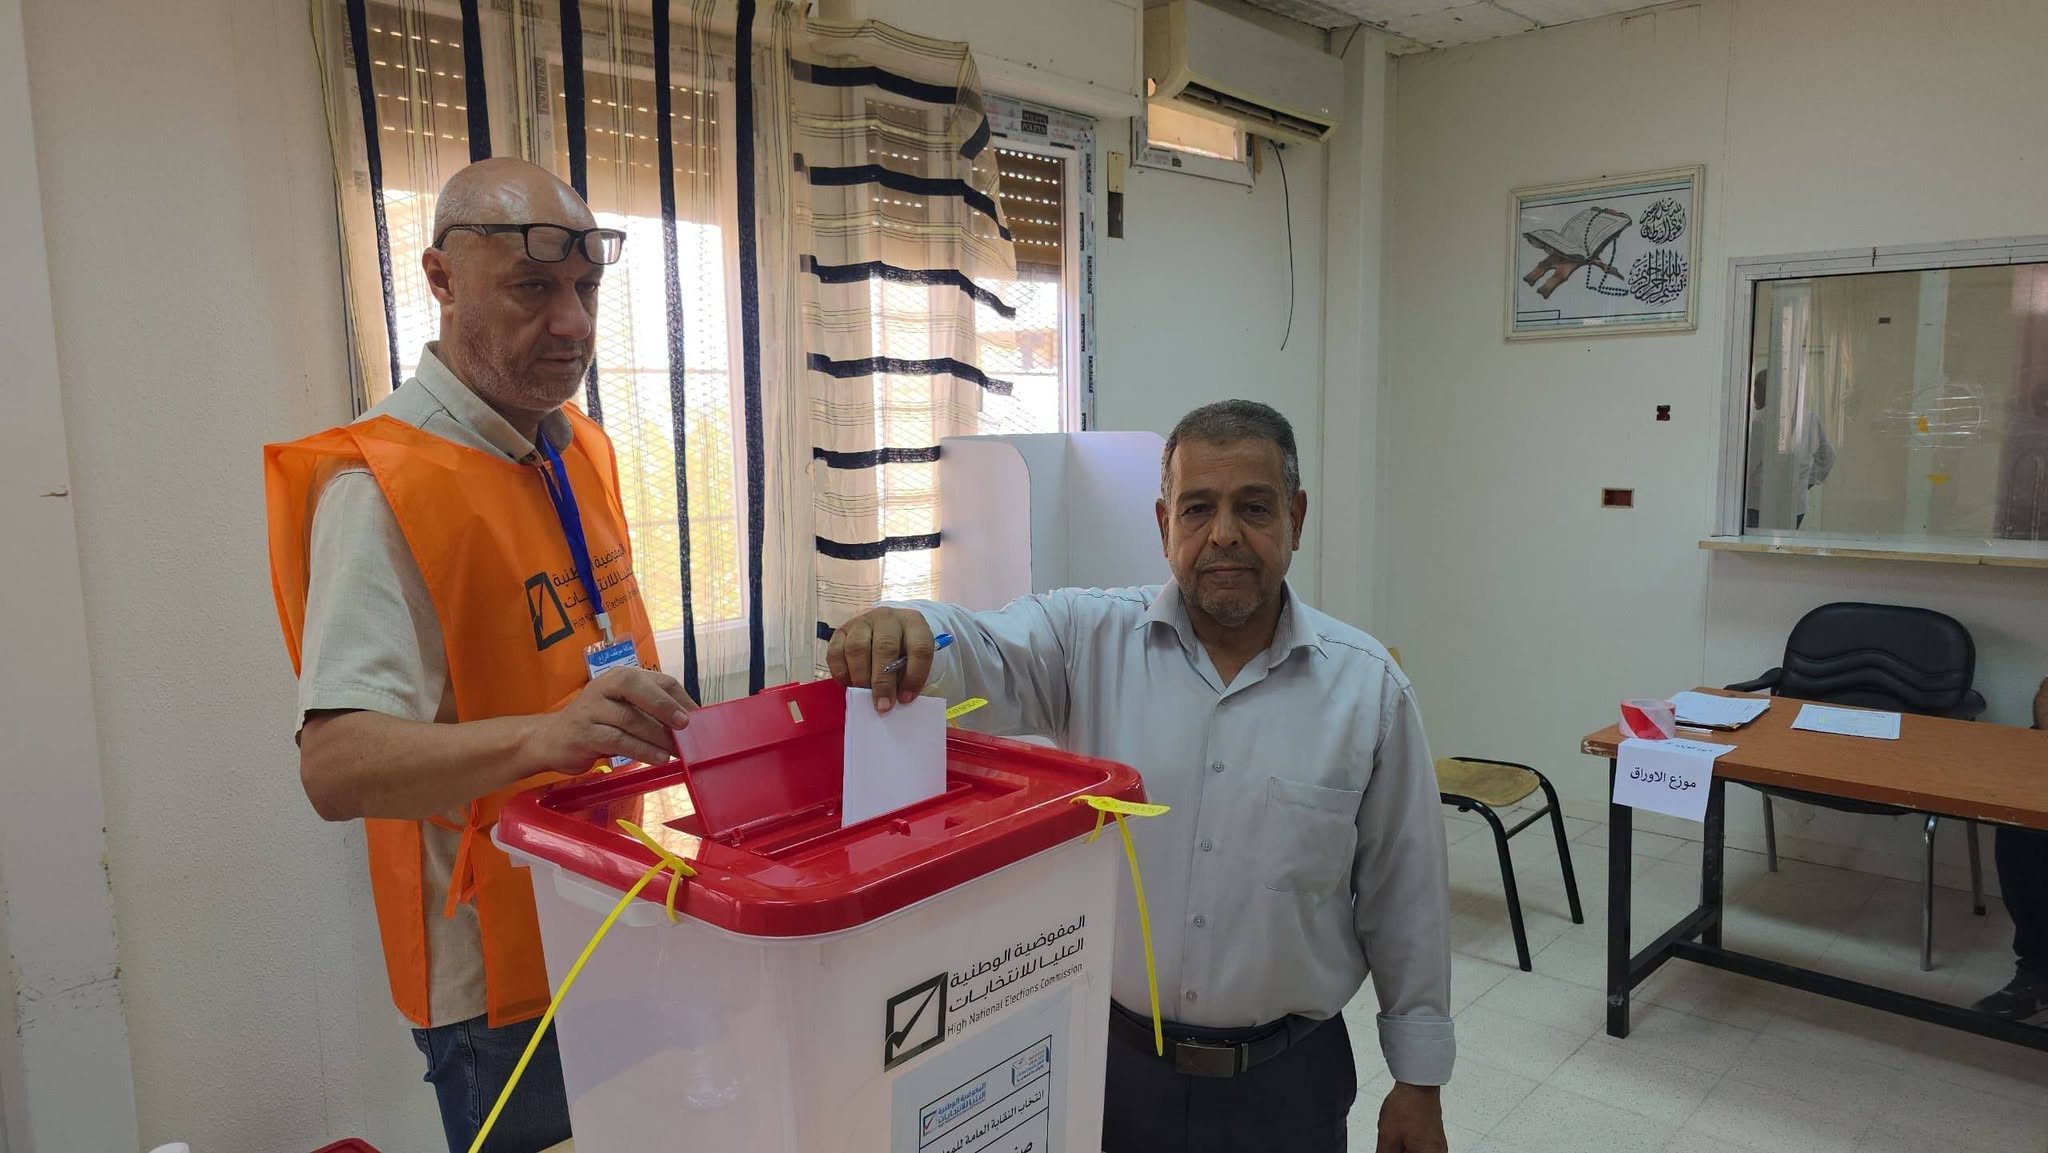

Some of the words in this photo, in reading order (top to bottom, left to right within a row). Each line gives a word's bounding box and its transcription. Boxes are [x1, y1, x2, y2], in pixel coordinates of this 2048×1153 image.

[1630, 766, 1666, 783] الاوراق
[1669, 775, 1697, 791] موزع
[1014, 914, 1085, 958] المفوضية
[950, 947, 1011, 988] الوطنية
[1039, 937, 1084, 968] العليا
[947, 1018, 967, 1037] High
[969, 998, 1003, 1024] National
[1005, 982, 1039, 1007] Elections
[1040, 963, 1083, 989] Commission
[949, 959, 1037, 1013] للانتخابات
[1018, 1089, 1044, 1115] انتخاب
[965, 1122, 989, 1145] العامة
